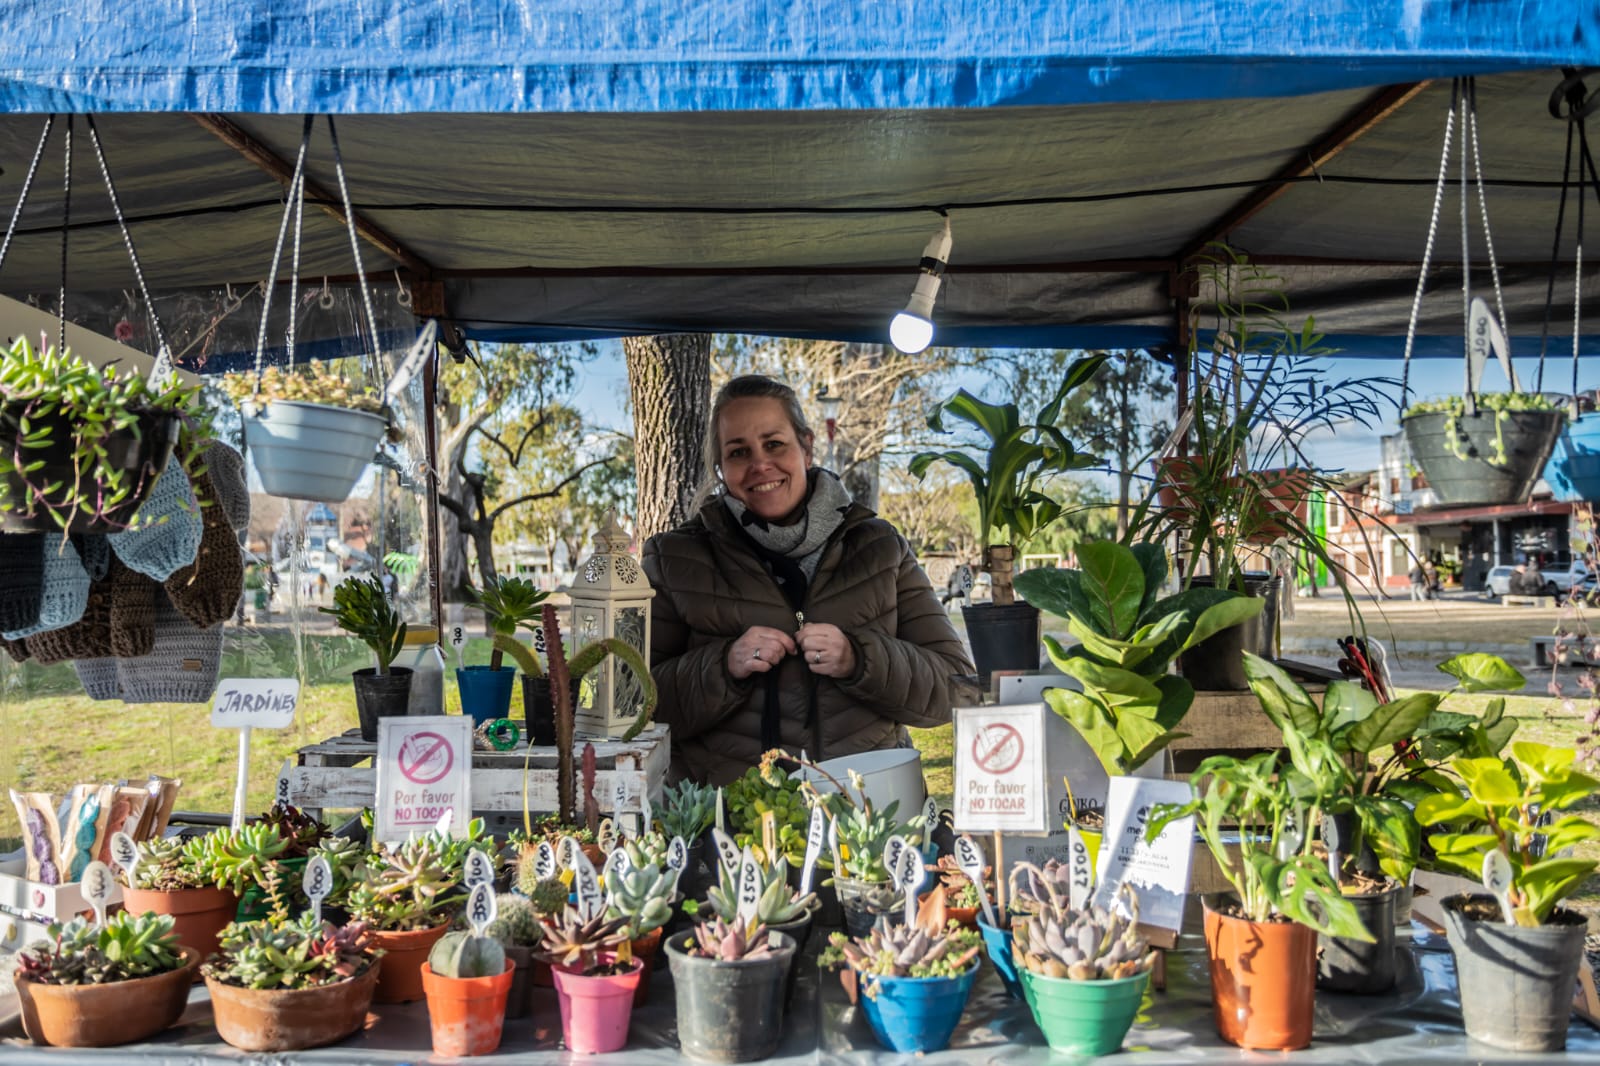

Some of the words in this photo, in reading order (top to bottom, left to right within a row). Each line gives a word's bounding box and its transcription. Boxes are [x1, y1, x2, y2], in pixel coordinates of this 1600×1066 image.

[453, 627, 462, 646] 700
[535, 628, 545, 653] 1200
[395, 790, 416, 805] Por
[422, 789, 455, 805] favor
[969, 780, 988, 795] Por
[995, 779, 1026, 795] favor
[395, 808, 412, 820] NO
[970, 797, 985, 810] NO
[989, 797, 1025, 810] TOCAR
[562, 840, 572, 865] 2000
[720, 841, 737, 869] 500
[958, 839, 978, 867] 1500
[1074, 842, 1088, 888] 2500
[903, 852, 916, 883] 2000
[744, 863, 755, 904] 2500
